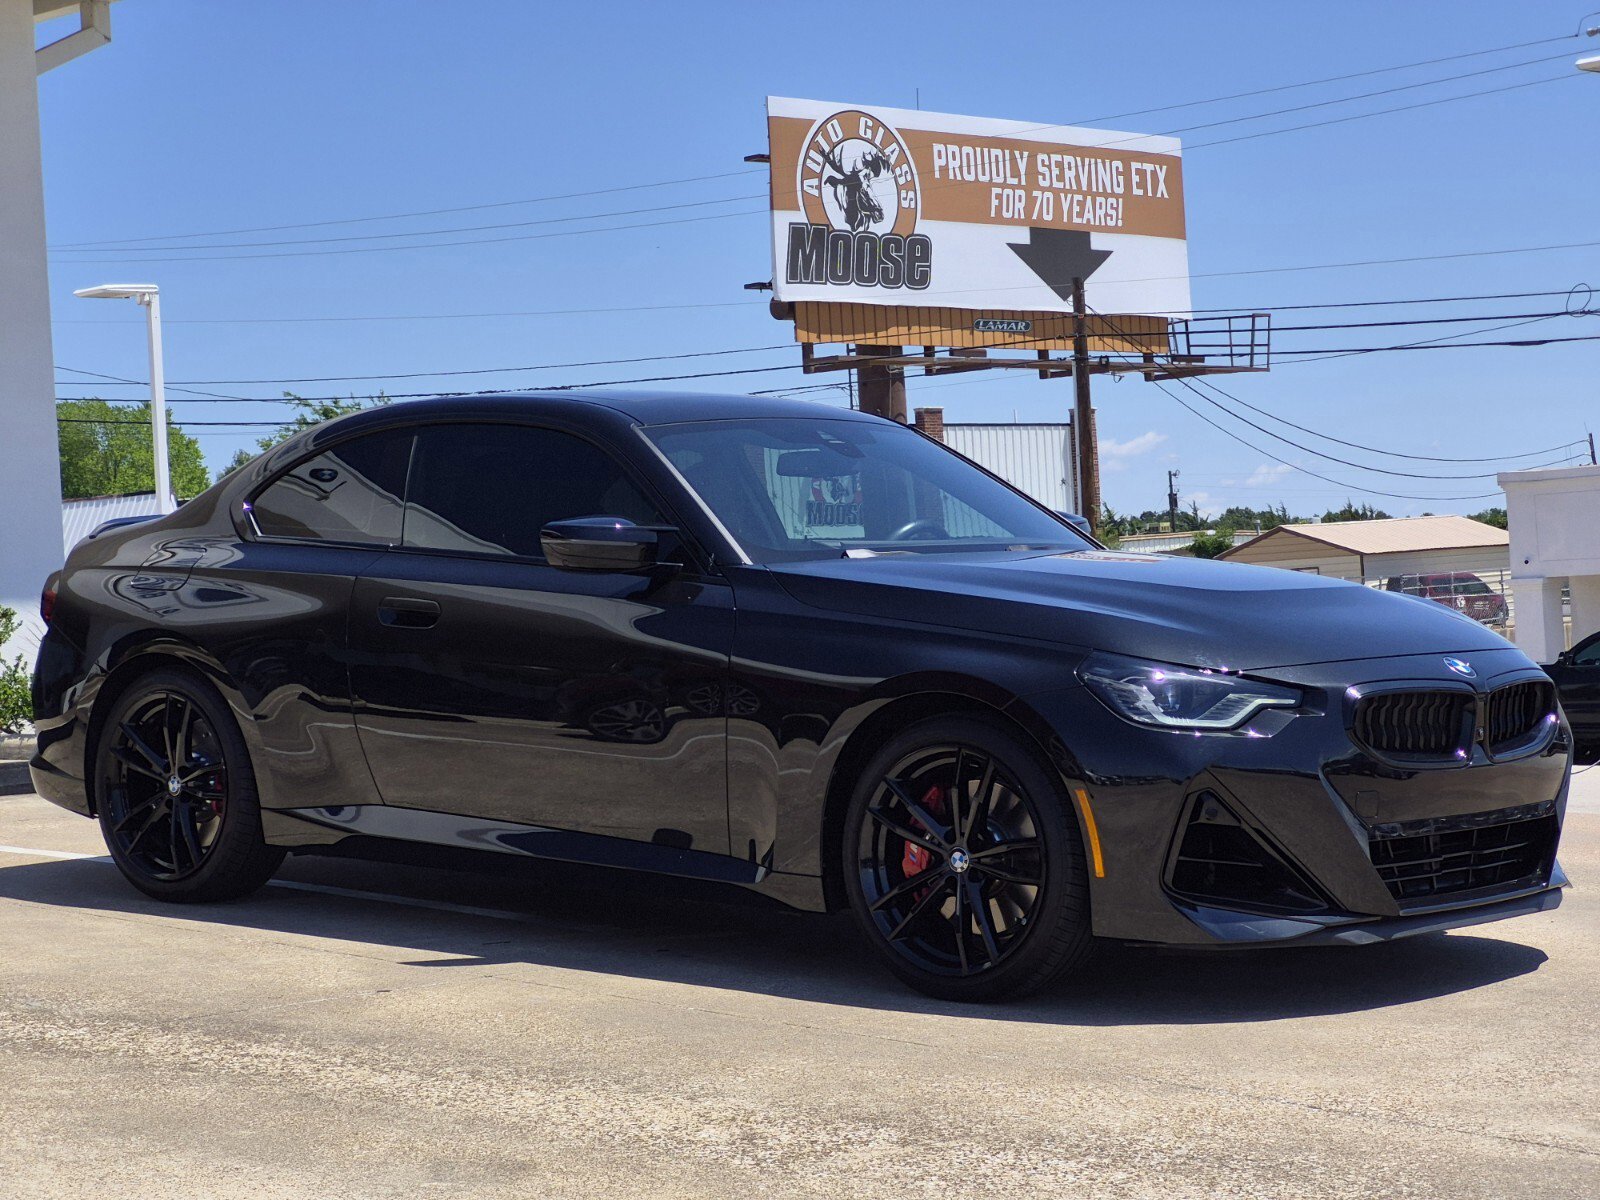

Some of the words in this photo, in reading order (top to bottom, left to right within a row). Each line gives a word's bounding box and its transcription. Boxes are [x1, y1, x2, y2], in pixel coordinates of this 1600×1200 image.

[803, 118, 845, 198] AUTO
[858, 116, 916, 209] GLASS
[932, 143, 1029, 186] PROUDLY
[1036, 153, 1125, 195] SERVING
[1130, 161, 1169, 199] ETX
[990, 187, 1026, 220] FOR
[1031, 190, 1054, 221] 70
[1060, 193, 1123, 227] YEARS!
[978, 320, 1026, 331] LAMAR
